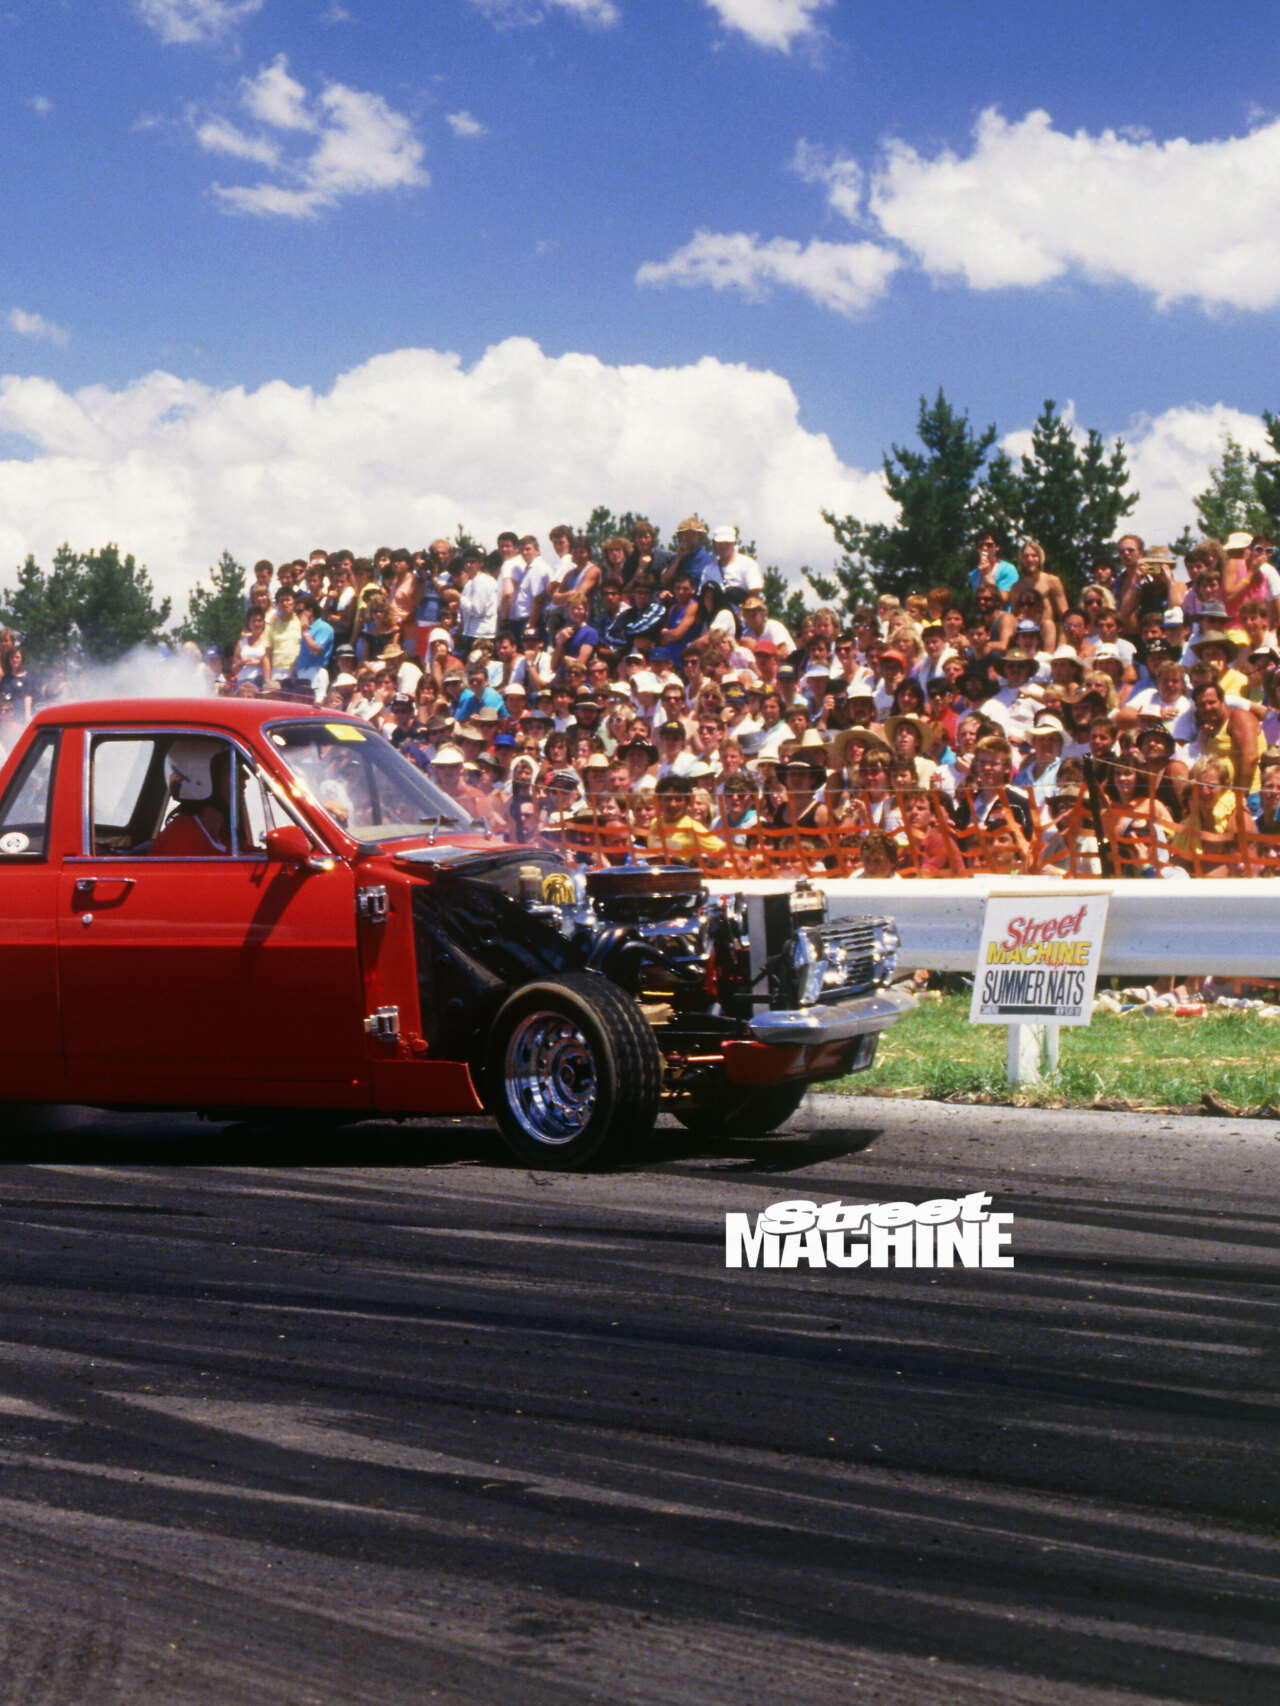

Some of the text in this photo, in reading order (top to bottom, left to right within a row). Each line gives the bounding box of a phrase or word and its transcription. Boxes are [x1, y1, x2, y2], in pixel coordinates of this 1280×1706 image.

[1001, 904, 1087, 950] Street
[986, 941, 1091, 965] MACHINE
[982, 970, 1085, 1005] SUMMER NATS
